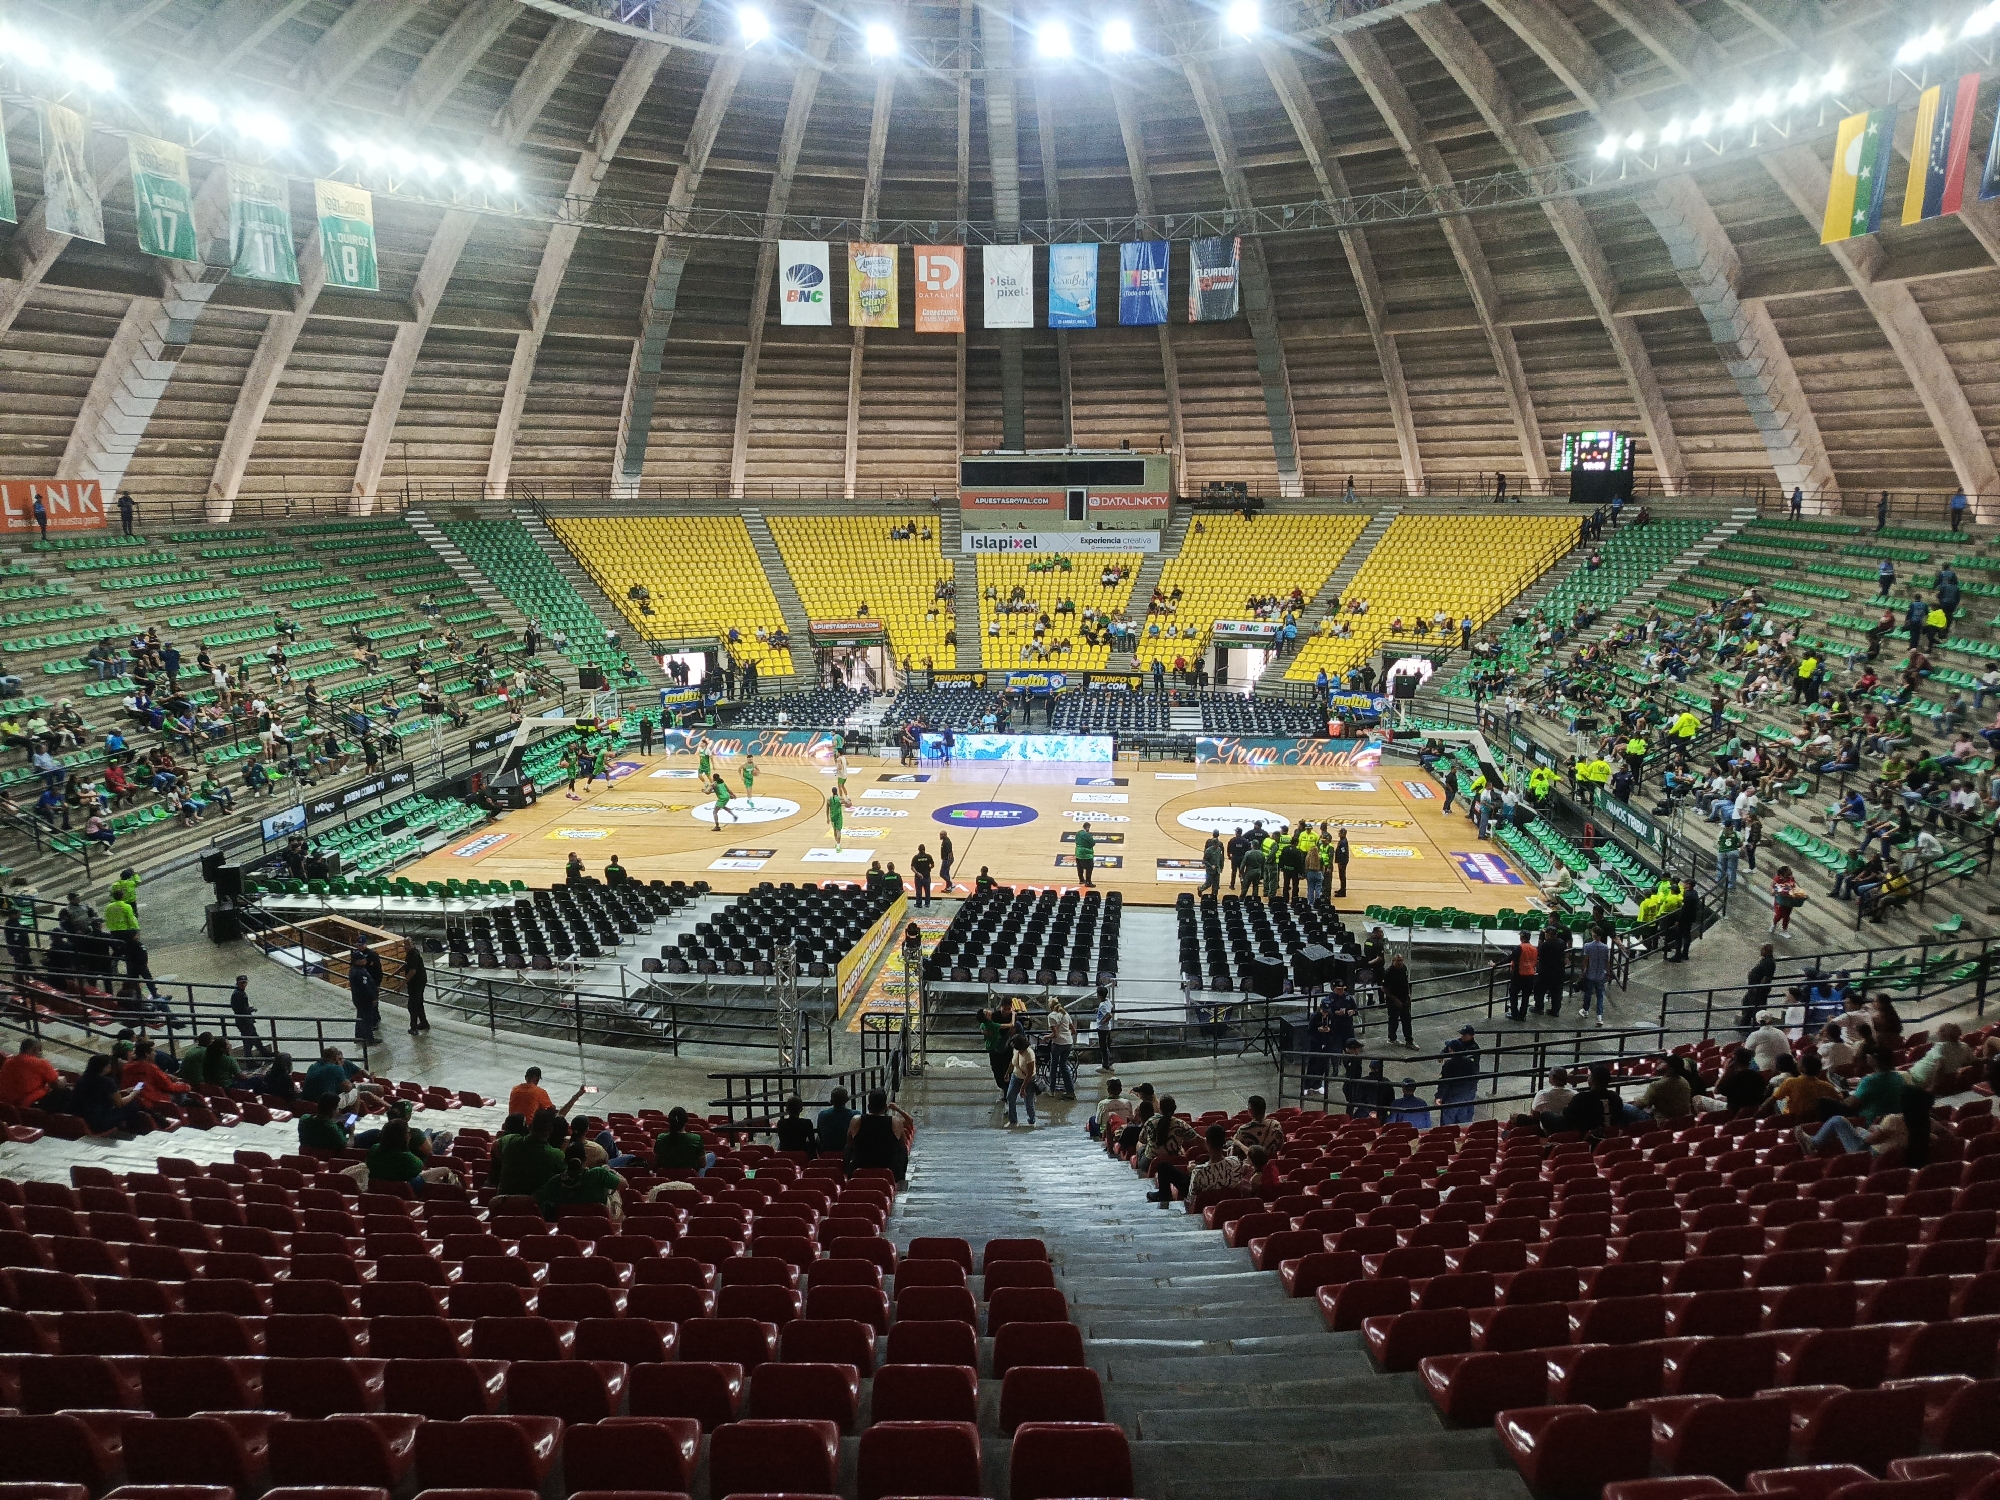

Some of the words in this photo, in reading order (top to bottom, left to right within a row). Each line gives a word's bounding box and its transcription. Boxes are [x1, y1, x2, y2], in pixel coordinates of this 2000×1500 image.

[324, 197, 365, 217] 1991-2009
[152, 209, 177, 253] 17
[338, 233, 369, 248] QUIROZ
[255, 233, 276, 274] 11
[342, 246, 359, 283] 8
[1196, 266, 1235, 278] ELEVATION
[787, 289, 824, 303] BNC
[997, 286, 1024, 299] pixel
[974, 496, 1049, 505] APUESTASROYAL.COM
[970, 535, 1038, 552] Islapixel
[1080, 536, 1121, 545] Experiencia
[1122, 536, 1152, 544] creativa
[813, 621, 879, 631] APUESTASROYAL.COM
[1216, 622, 1236, 631] BNC
[1239, 623, 1260, 632] BNC
[933, 674, 972, 682] TRIUNFO
[1089, 675, 1128, 683] TRIUNFO
[747, 731, 821, 758] Final
[1206, 738, 1279, 765] Gran
[1283, 738, 1366, 766] Final
[1725, 838, 1732, 847] 6
